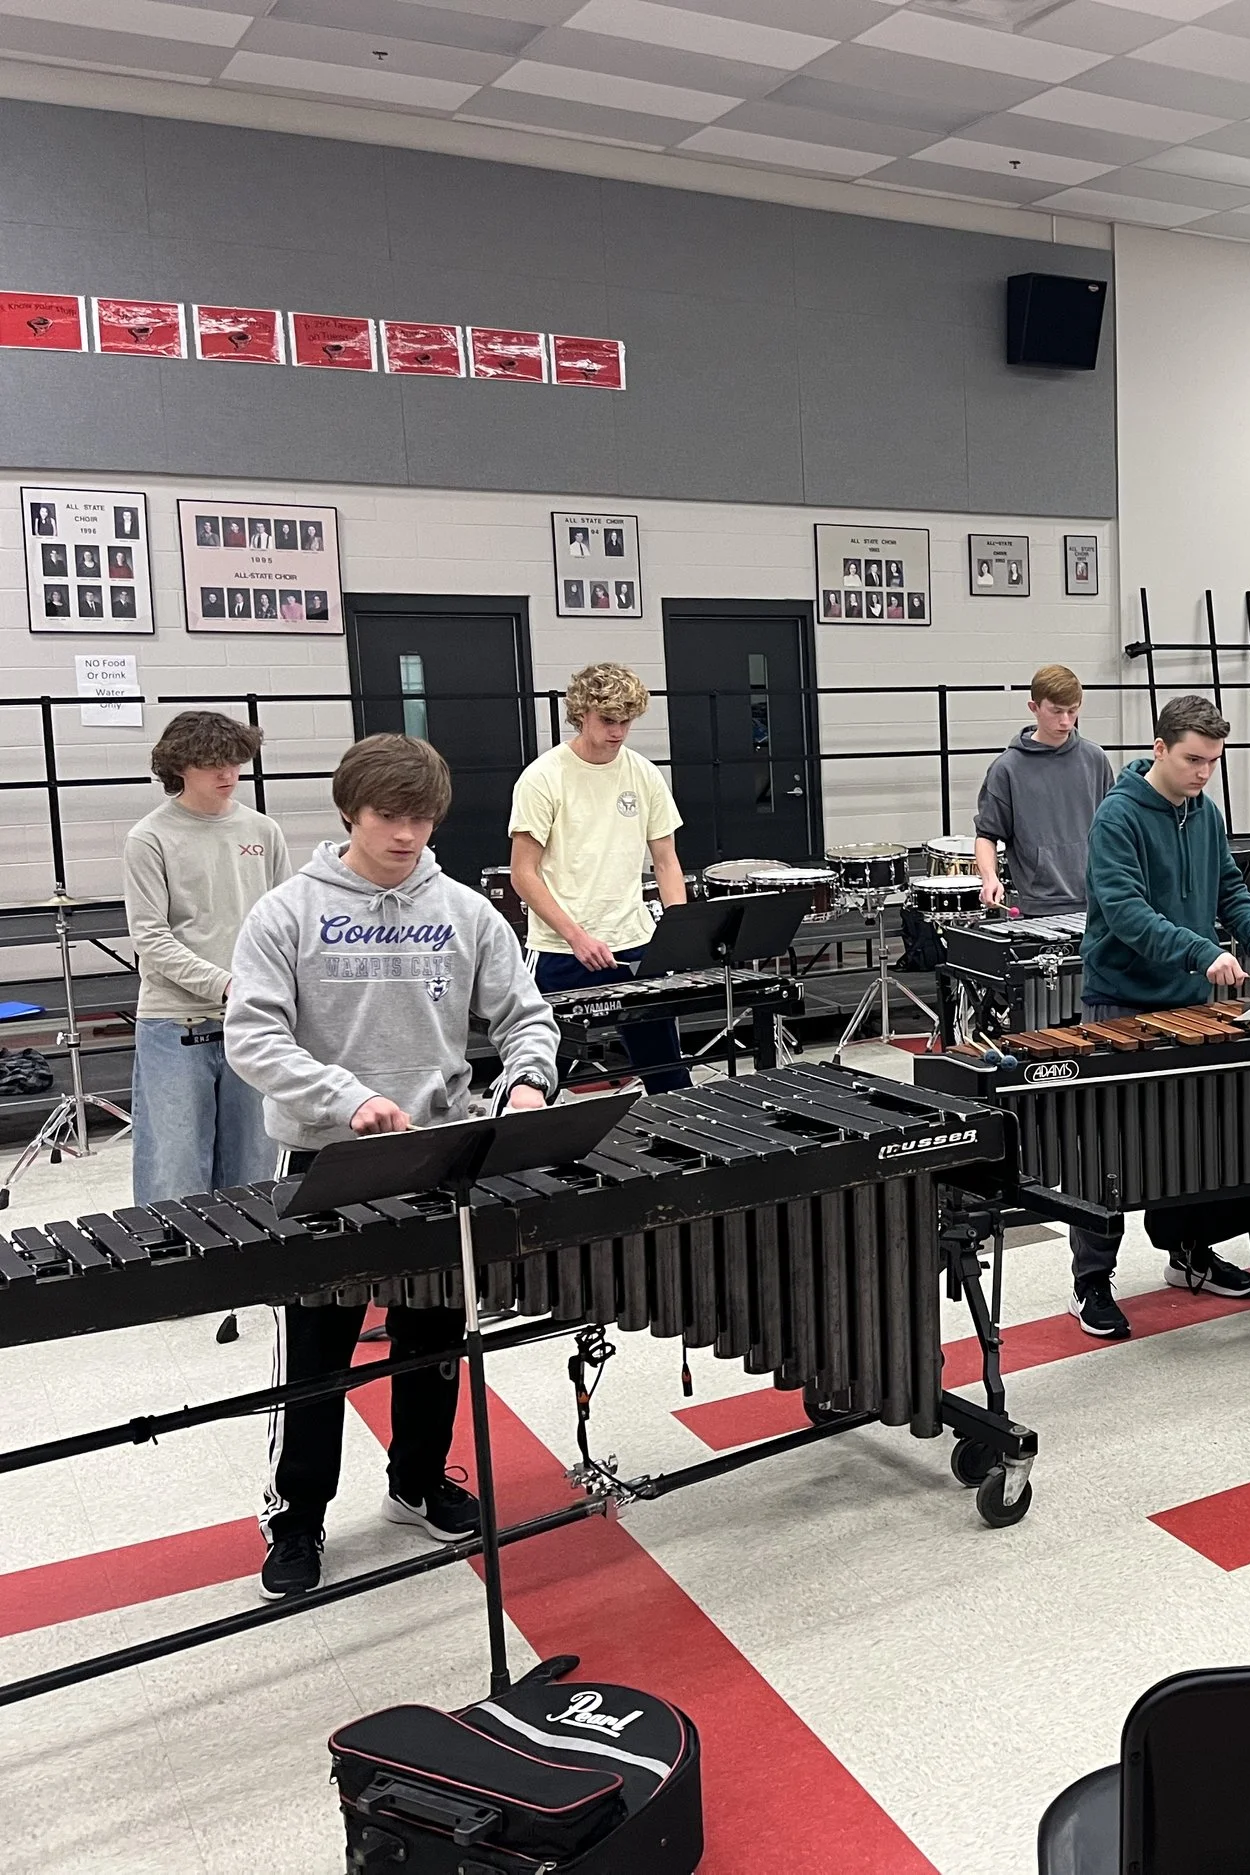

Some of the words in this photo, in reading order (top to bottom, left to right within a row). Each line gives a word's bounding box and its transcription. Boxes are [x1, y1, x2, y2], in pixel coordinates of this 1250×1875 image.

[581, 517, 602, 525] STATE
[85, 659, 100, 667] NO
[102, 659, 126, 667] Food
[87, 672, 99, 680] Or
[101, 671, 126, 680] Drink
[95, 688, 125, 697] Water
[320, 914, 456, 952] Conway
[410, 955, 453, 977] CATS
[584, 1000, 622, 1015] YAMAHA
[1032, 1062, 1073, 1082] ADAMS
[546, 1691, 644, 1738] Pearl
